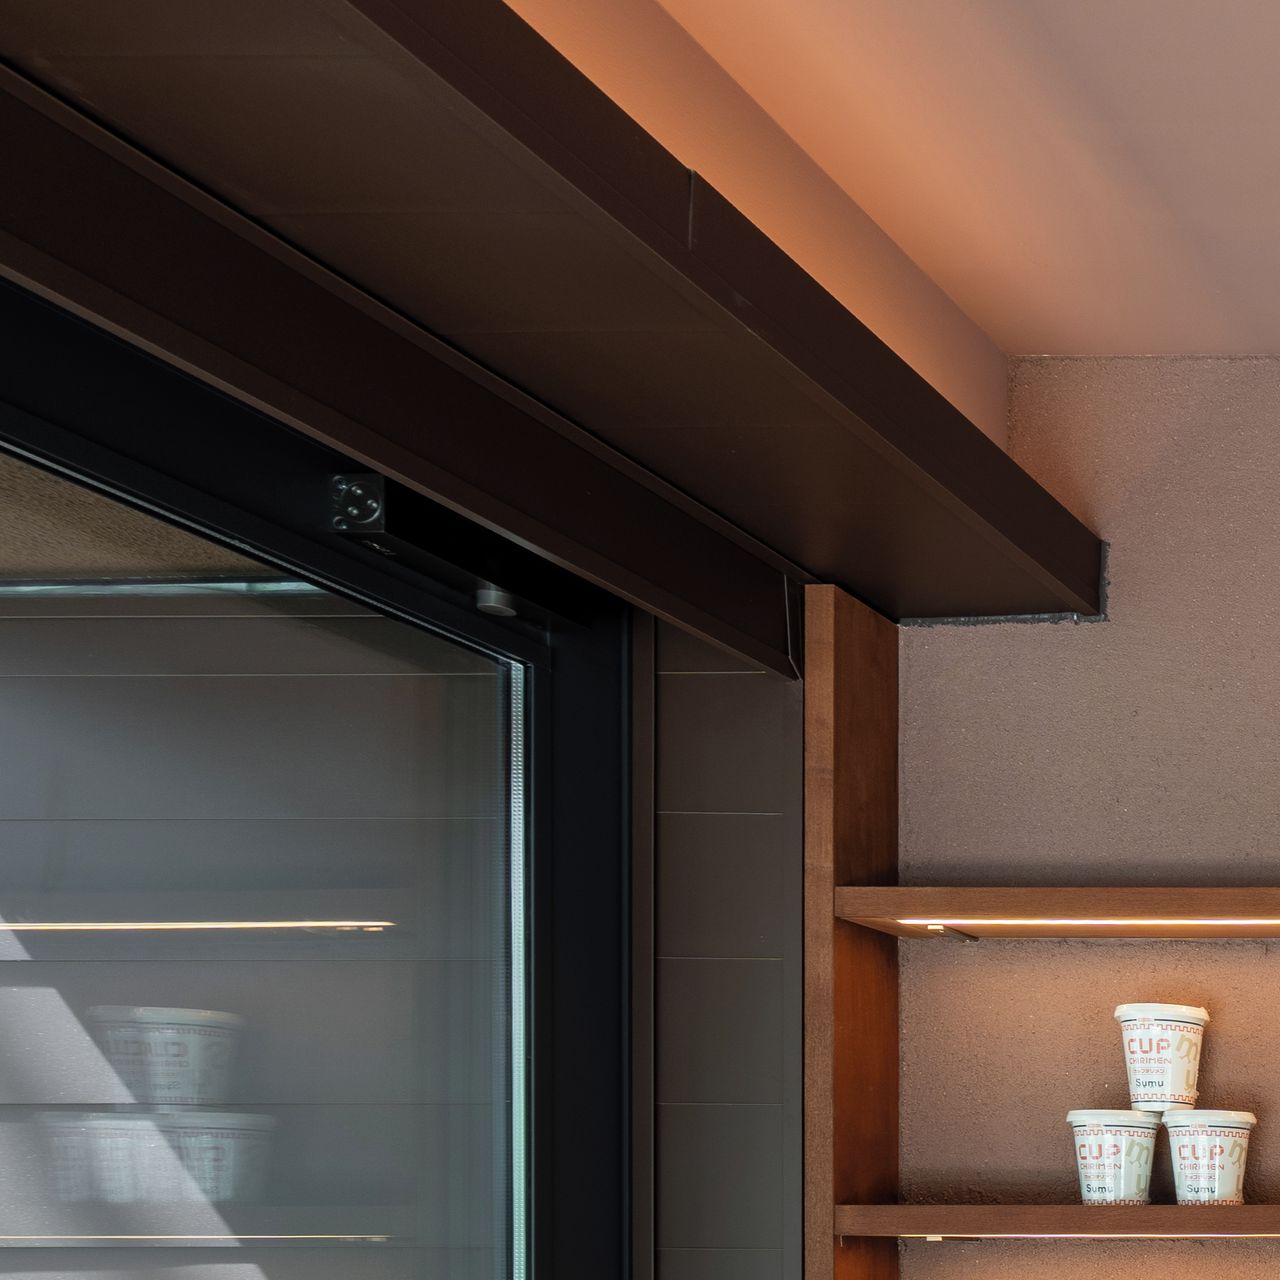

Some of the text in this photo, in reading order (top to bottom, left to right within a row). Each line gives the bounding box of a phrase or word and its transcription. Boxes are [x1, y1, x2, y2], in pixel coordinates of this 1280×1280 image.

[1127, 1038, 1171, 1055] CUP
[1128, 1057, 1172, 1065] CHIRIMEN
[1135, 1078, 1164, 1088] Sumu
[1178, 1144, 1225, 1161] CUP
[1186, 1184, 1216, 1194] Sumu
